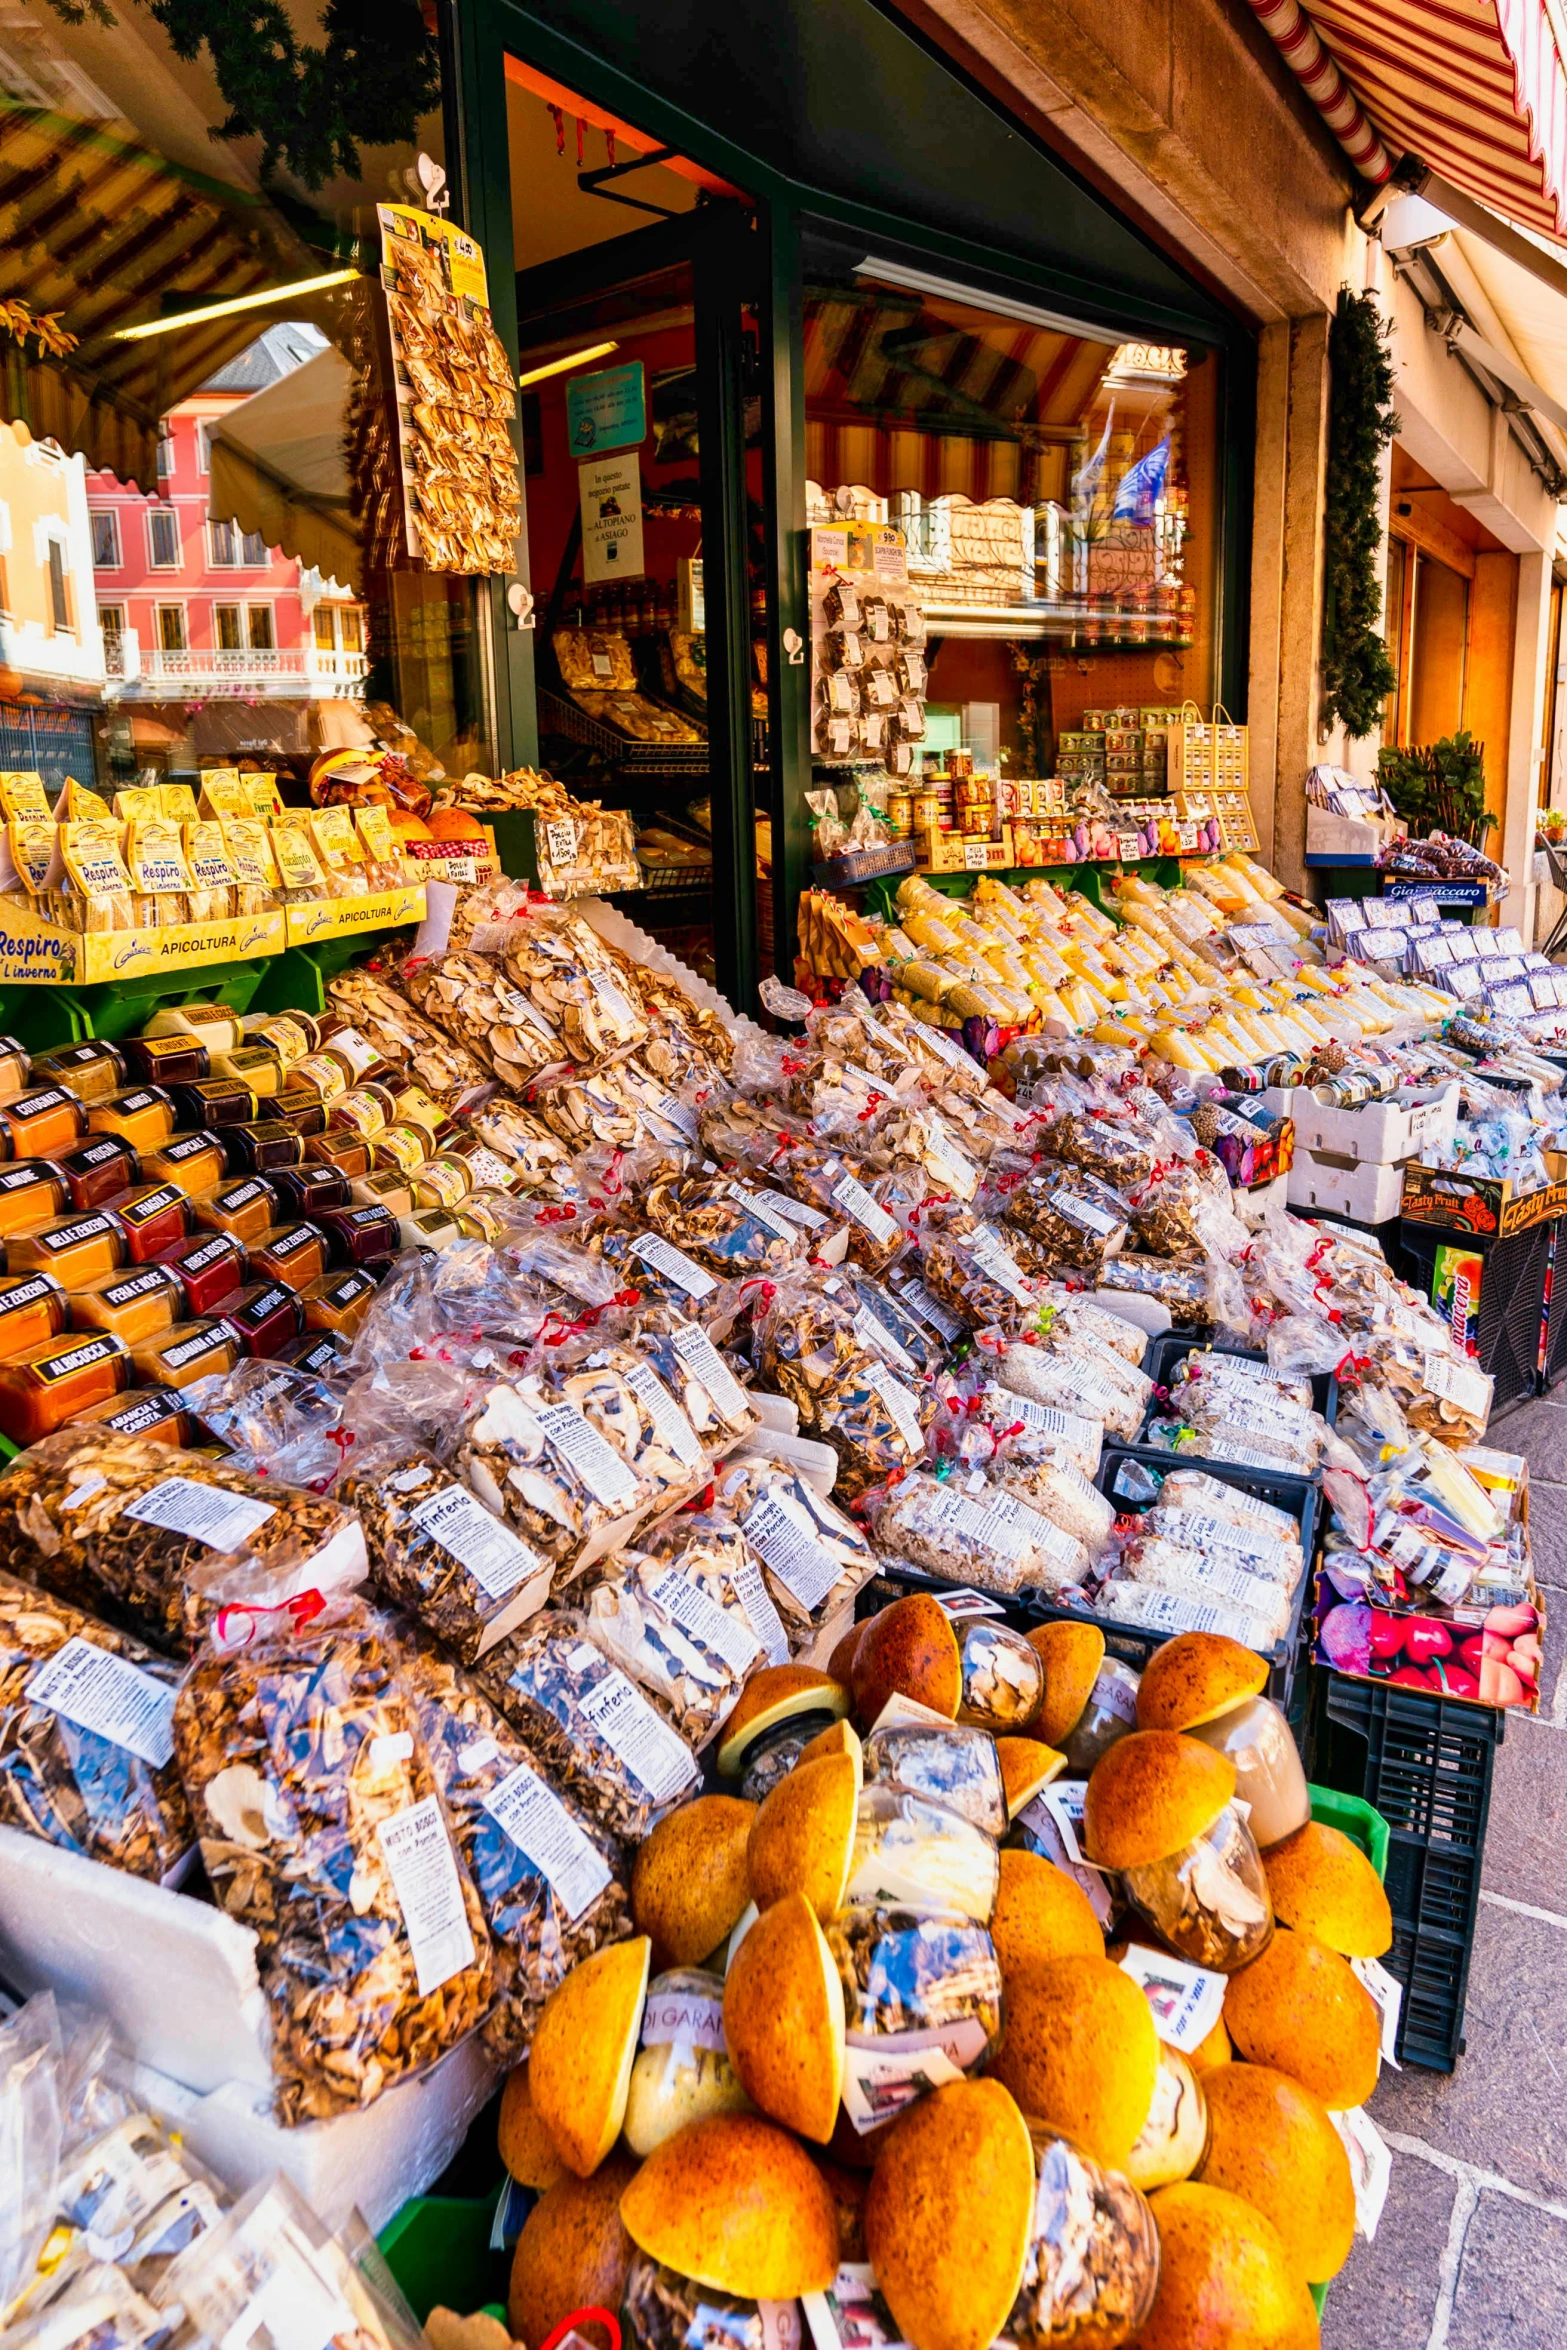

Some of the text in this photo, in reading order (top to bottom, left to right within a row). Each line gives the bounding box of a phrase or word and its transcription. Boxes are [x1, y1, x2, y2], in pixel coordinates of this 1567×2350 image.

[595, 471, 622, 484] In questo
[594, 514, 636, 530] ALTOPIANO
[600, 528, 628, 542] ASIAGO
[195, 862, 228, 878] Respiro
[282, 853, 311, 869] Eucalipto
[82, 864, 119, 884] Respiro
[142, 862, 180, 884] Respiro
[338, 906, 392, 924] APICOLTURA
[0, 931, 61, 964] Respiro
[161, 935, 237, 956] APICOLTURA
[157, 1039, 192, 1051] FONDENTE
[123, 1092, 153, 1110] MANGO
[83, 1142, 121, 1163] PRUGNA
[168, 1137, 207, 1159] TROPICALE
[0, 1169, 39, 1188] LIMONE
[135, 1192, 173, 1216] FRAGOLA
[1401, 1193, 1460, 1210] Tasty Fruit
[1503, 1193, 1545, 1231] Tasty
[45, 1230, 71, 1249] MELA
[75, 1216, 109, 1239] ZENZERO
[183, 1238, 231, 1270] RIBES ROSSO
[9, 1280, 49, 1305] ZENZERO
[107, 1284, 135, 1304] PERA
[140, 1271, 166, 1290] NOCE
[250, 1288, 286, 1317] LAMPONE
[672, 1333, 687, 1344] Misto
[50, 1342, 110, 1376] ALBICOCCA
[1426, 1357, 1437, 1390] PORCINI
[110, 1403, 152, 1429] ARANCIA
[122, 1411, 162, 1435] CAROTA
[535, 1410, 556, 1424] Misto
[549, 1417, 583, 1436] con Porcini
[134, 1482, 185, 1516] MISTO BOSCO
[421, 1496, 471, 1531] finferla
[742, 1501, 777, 1537] Misto funghi
[754, 1514, 787, 1548] con Porcini
[733, 1571, 749, 1585] Misto
[652, 1582, 669, 1600] Misto
[743, 1590, 753, 1600] con
[669, 1598, 680, 1610] con
[40, 1648, 90, 1700] MISTO BOSCO
[588, 1685, 632, 1728] finferla
[493, 1795, 516, 1816] MISTO
[385, 1824, 413, 1847] MISTO
[661, 2006, 724, 2037] GARA
